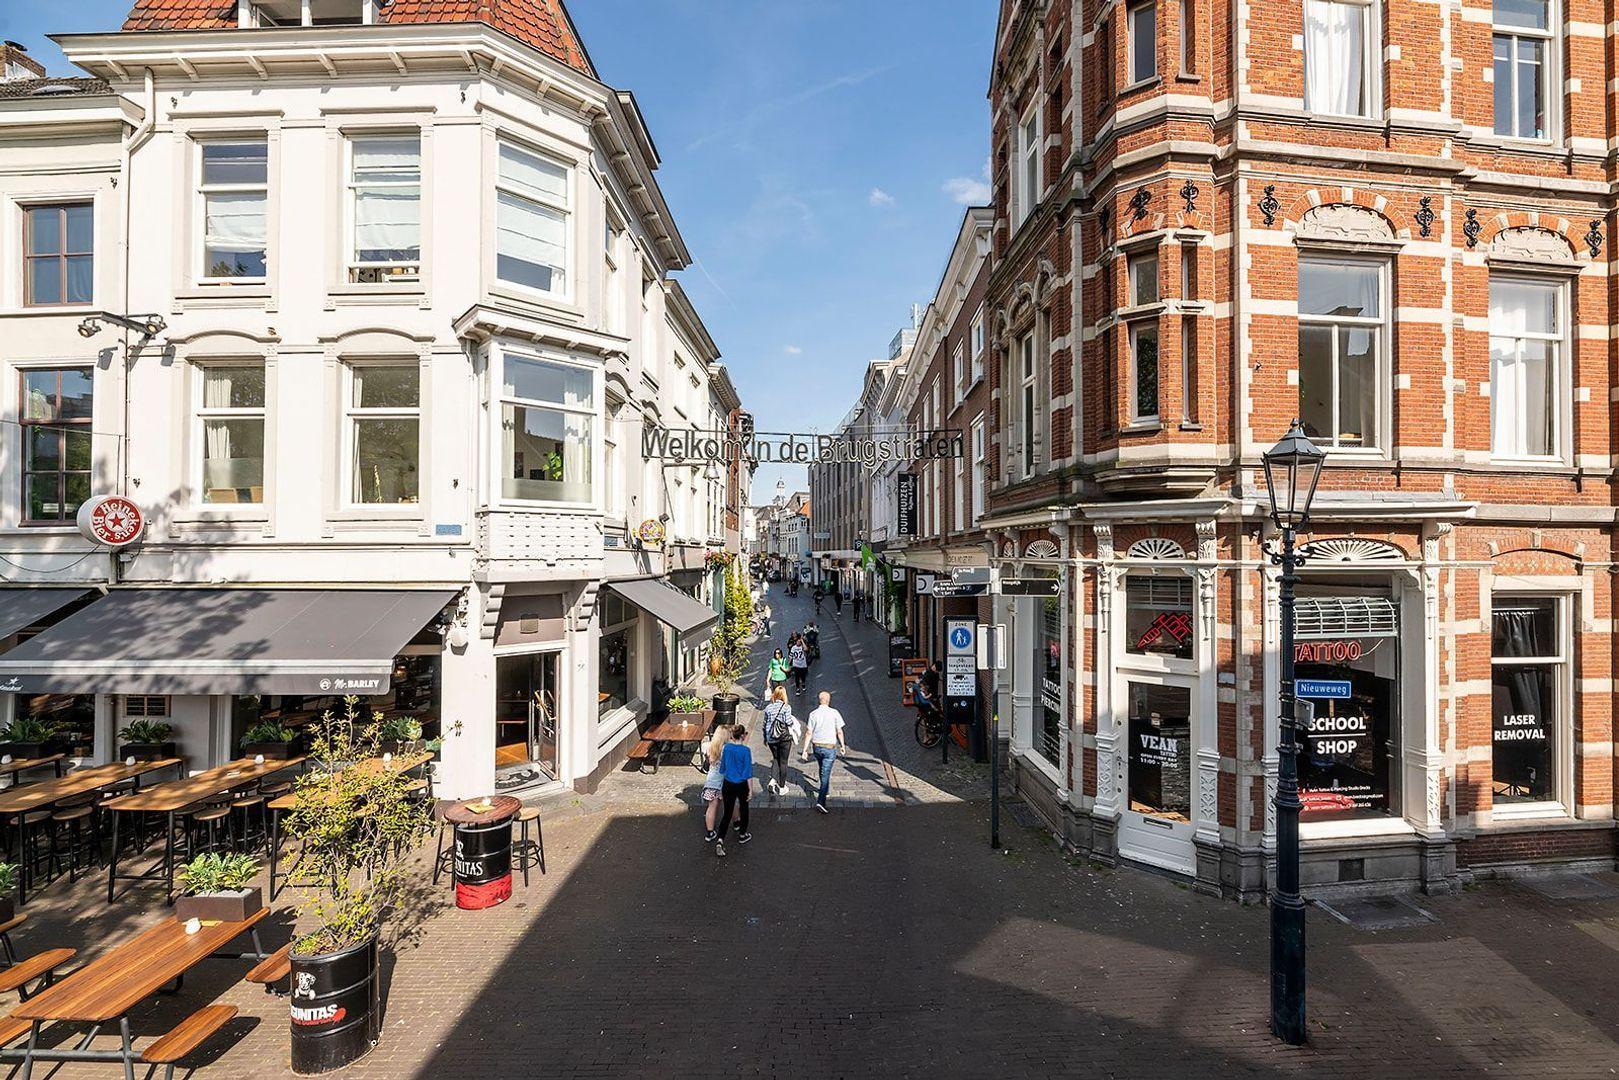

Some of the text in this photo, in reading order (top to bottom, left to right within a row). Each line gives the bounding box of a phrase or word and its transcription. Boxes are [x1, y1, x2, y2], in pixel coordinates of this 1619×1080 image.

[641, 428, 744, 461] Welkom
[779, 433, 808, 462] de
[816, 433, 964, 469] Brugstraten
[900, 481, 909, 534] DUIFHUIZEN
[93, 516, 111, 540] Bier
[1294, 641, 1362, 663] TATTOO
[347, 679, 380, 688] BARLEY
[1300, 683, 1348, 696] Nieuweweg
[1503, 714, 1536, 726] LASER
[1494, 728, 1546, 741] REMOVAL
[1140, 734, 1178, 752] VEAN
[1316, 740, 1358, 755] SHOP
